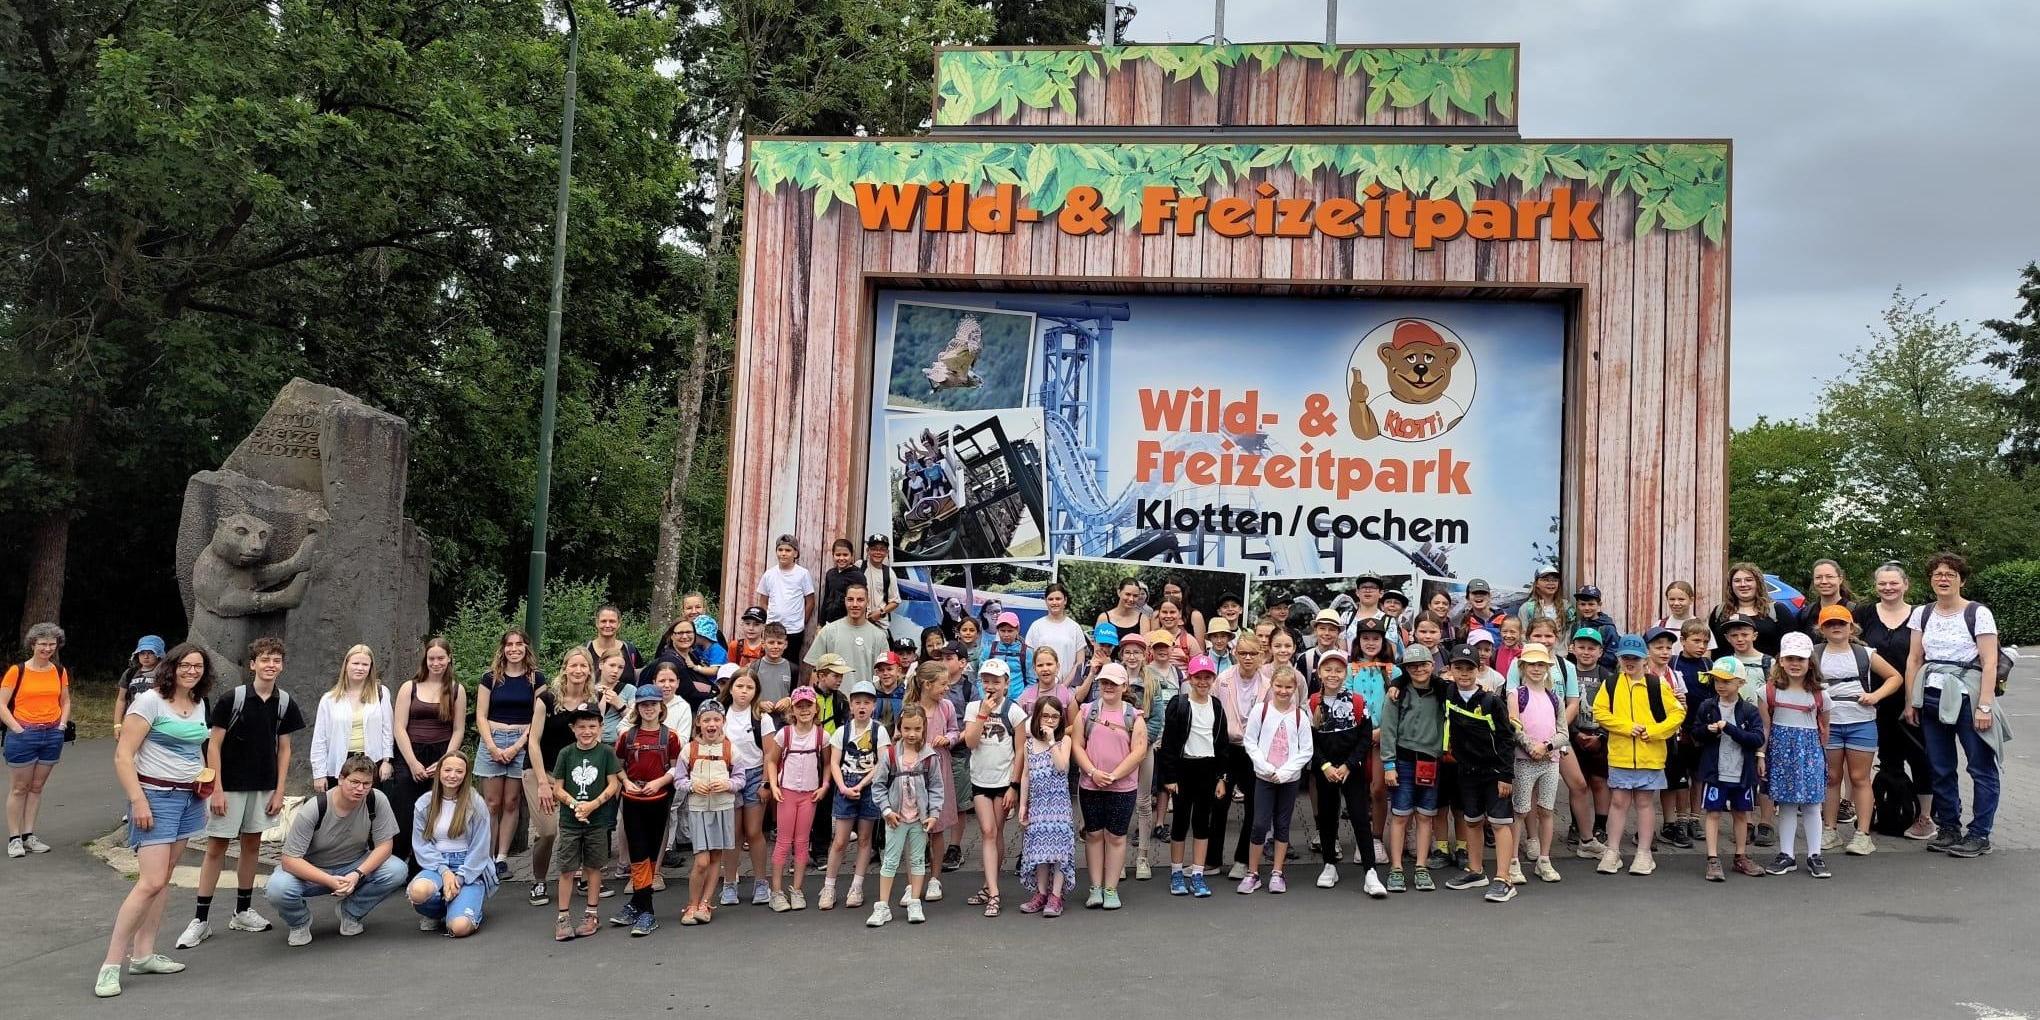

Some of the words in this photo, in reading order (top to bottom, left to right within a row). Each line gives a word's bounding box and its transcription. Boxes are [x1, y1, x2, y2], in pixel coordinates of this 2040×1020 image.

[855, 181, 1040, 233] Wild-
[1059, 186, 1109, 235] &
[1142, 181, 1601, 251] Freizeitpark
[1137, 386, 1279, 435] Wild-
[1299, 393, 1339, 438] &
[1136, 439, 1473, 500] Freizeitpark
